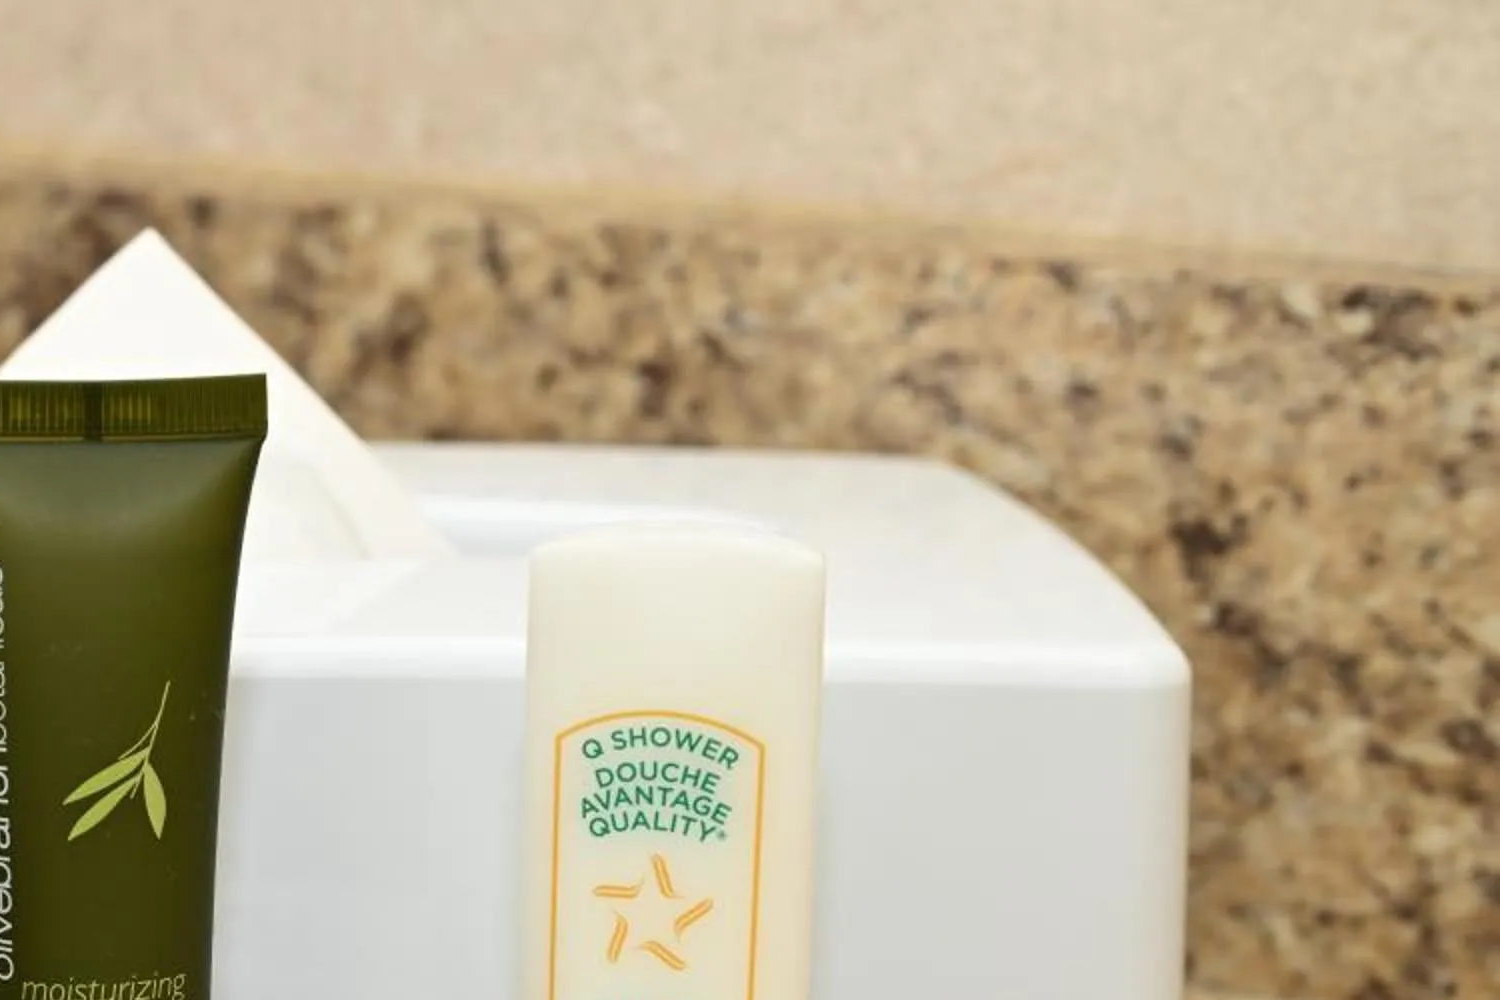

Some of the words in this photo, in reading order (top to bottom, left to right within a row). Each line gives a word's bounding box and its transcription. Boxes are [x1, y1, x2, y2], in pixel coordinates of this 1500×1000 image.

[581, 739, 604, 759] Q
[610, 726, 739, 770] SHOWER
[595, 761, 721, 794] DOUCHE
[581, 785, 733, 826] AVANTAGE
